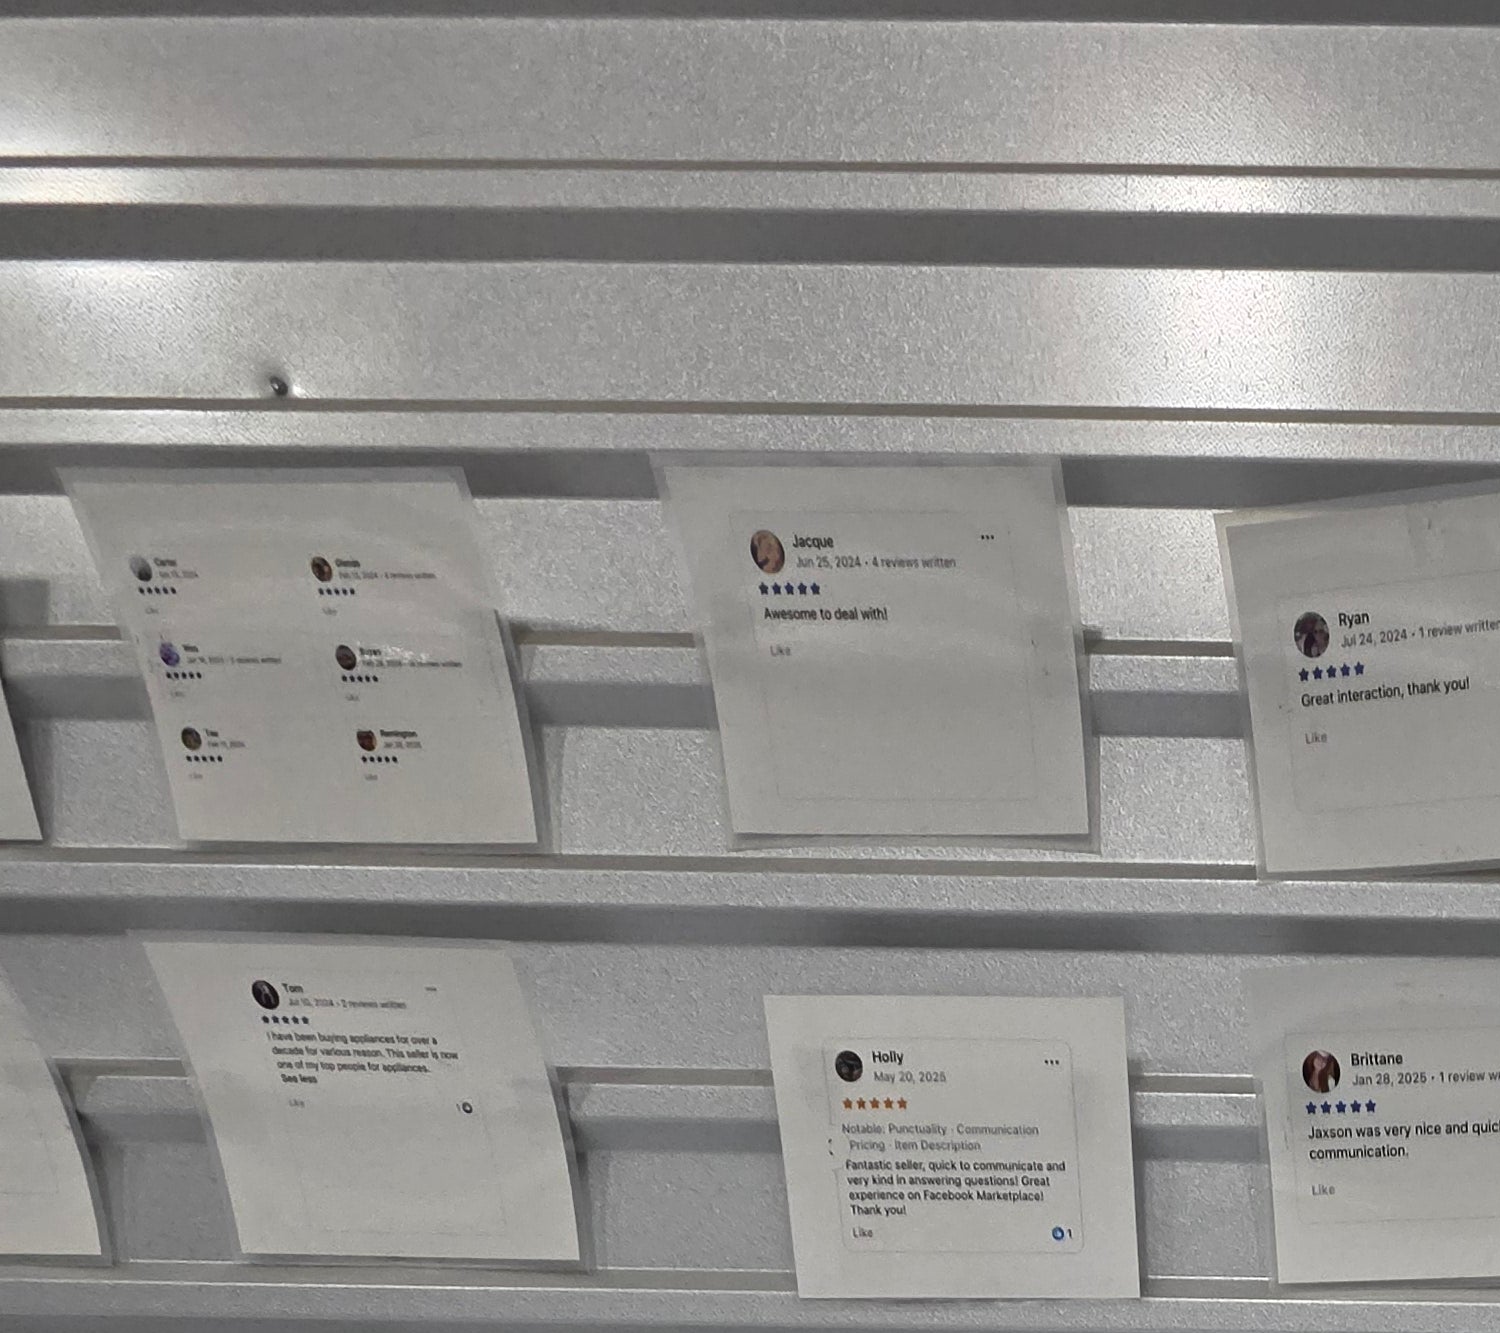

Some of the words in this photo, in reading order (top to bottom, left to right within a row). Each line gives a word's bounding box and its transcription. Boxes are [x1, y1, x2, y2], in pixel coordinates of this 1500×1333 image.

[1338, 613, 1369, 629] Ryan
[1341, 634, 1356, 648] Jul
[1359, 632, 1376, 647] 24,
[1379, 628, 1407, 643] 2024
[1419, 626, 1424, 638] 1
[1427, 625, 1462, 638] review
[1301, 692, 1334, 707] Great
[1407, 679, 1441, 696] thank
[1443, 676, 1469, 695] you!
[1351, 1052, 1403, 1066] Brittane
[1352, 1074, 1372, 1086] Jan
[1376, 1072, 1393, 1087] 28,
[1440, 1071, 1444, 1083] 1
[1448, 1070, 1485, 1083] review
[1308, 1126, 1352, 1139] Jaxson
[1356, 1127, 1381, 1137] was
[1384, 1126, 1411, 1139] very
[1415, 1122, 1441, 1136] nice
[1445, 1121, 1468, 1135] and
[1309, 1144, 1408, 1160] communication.
